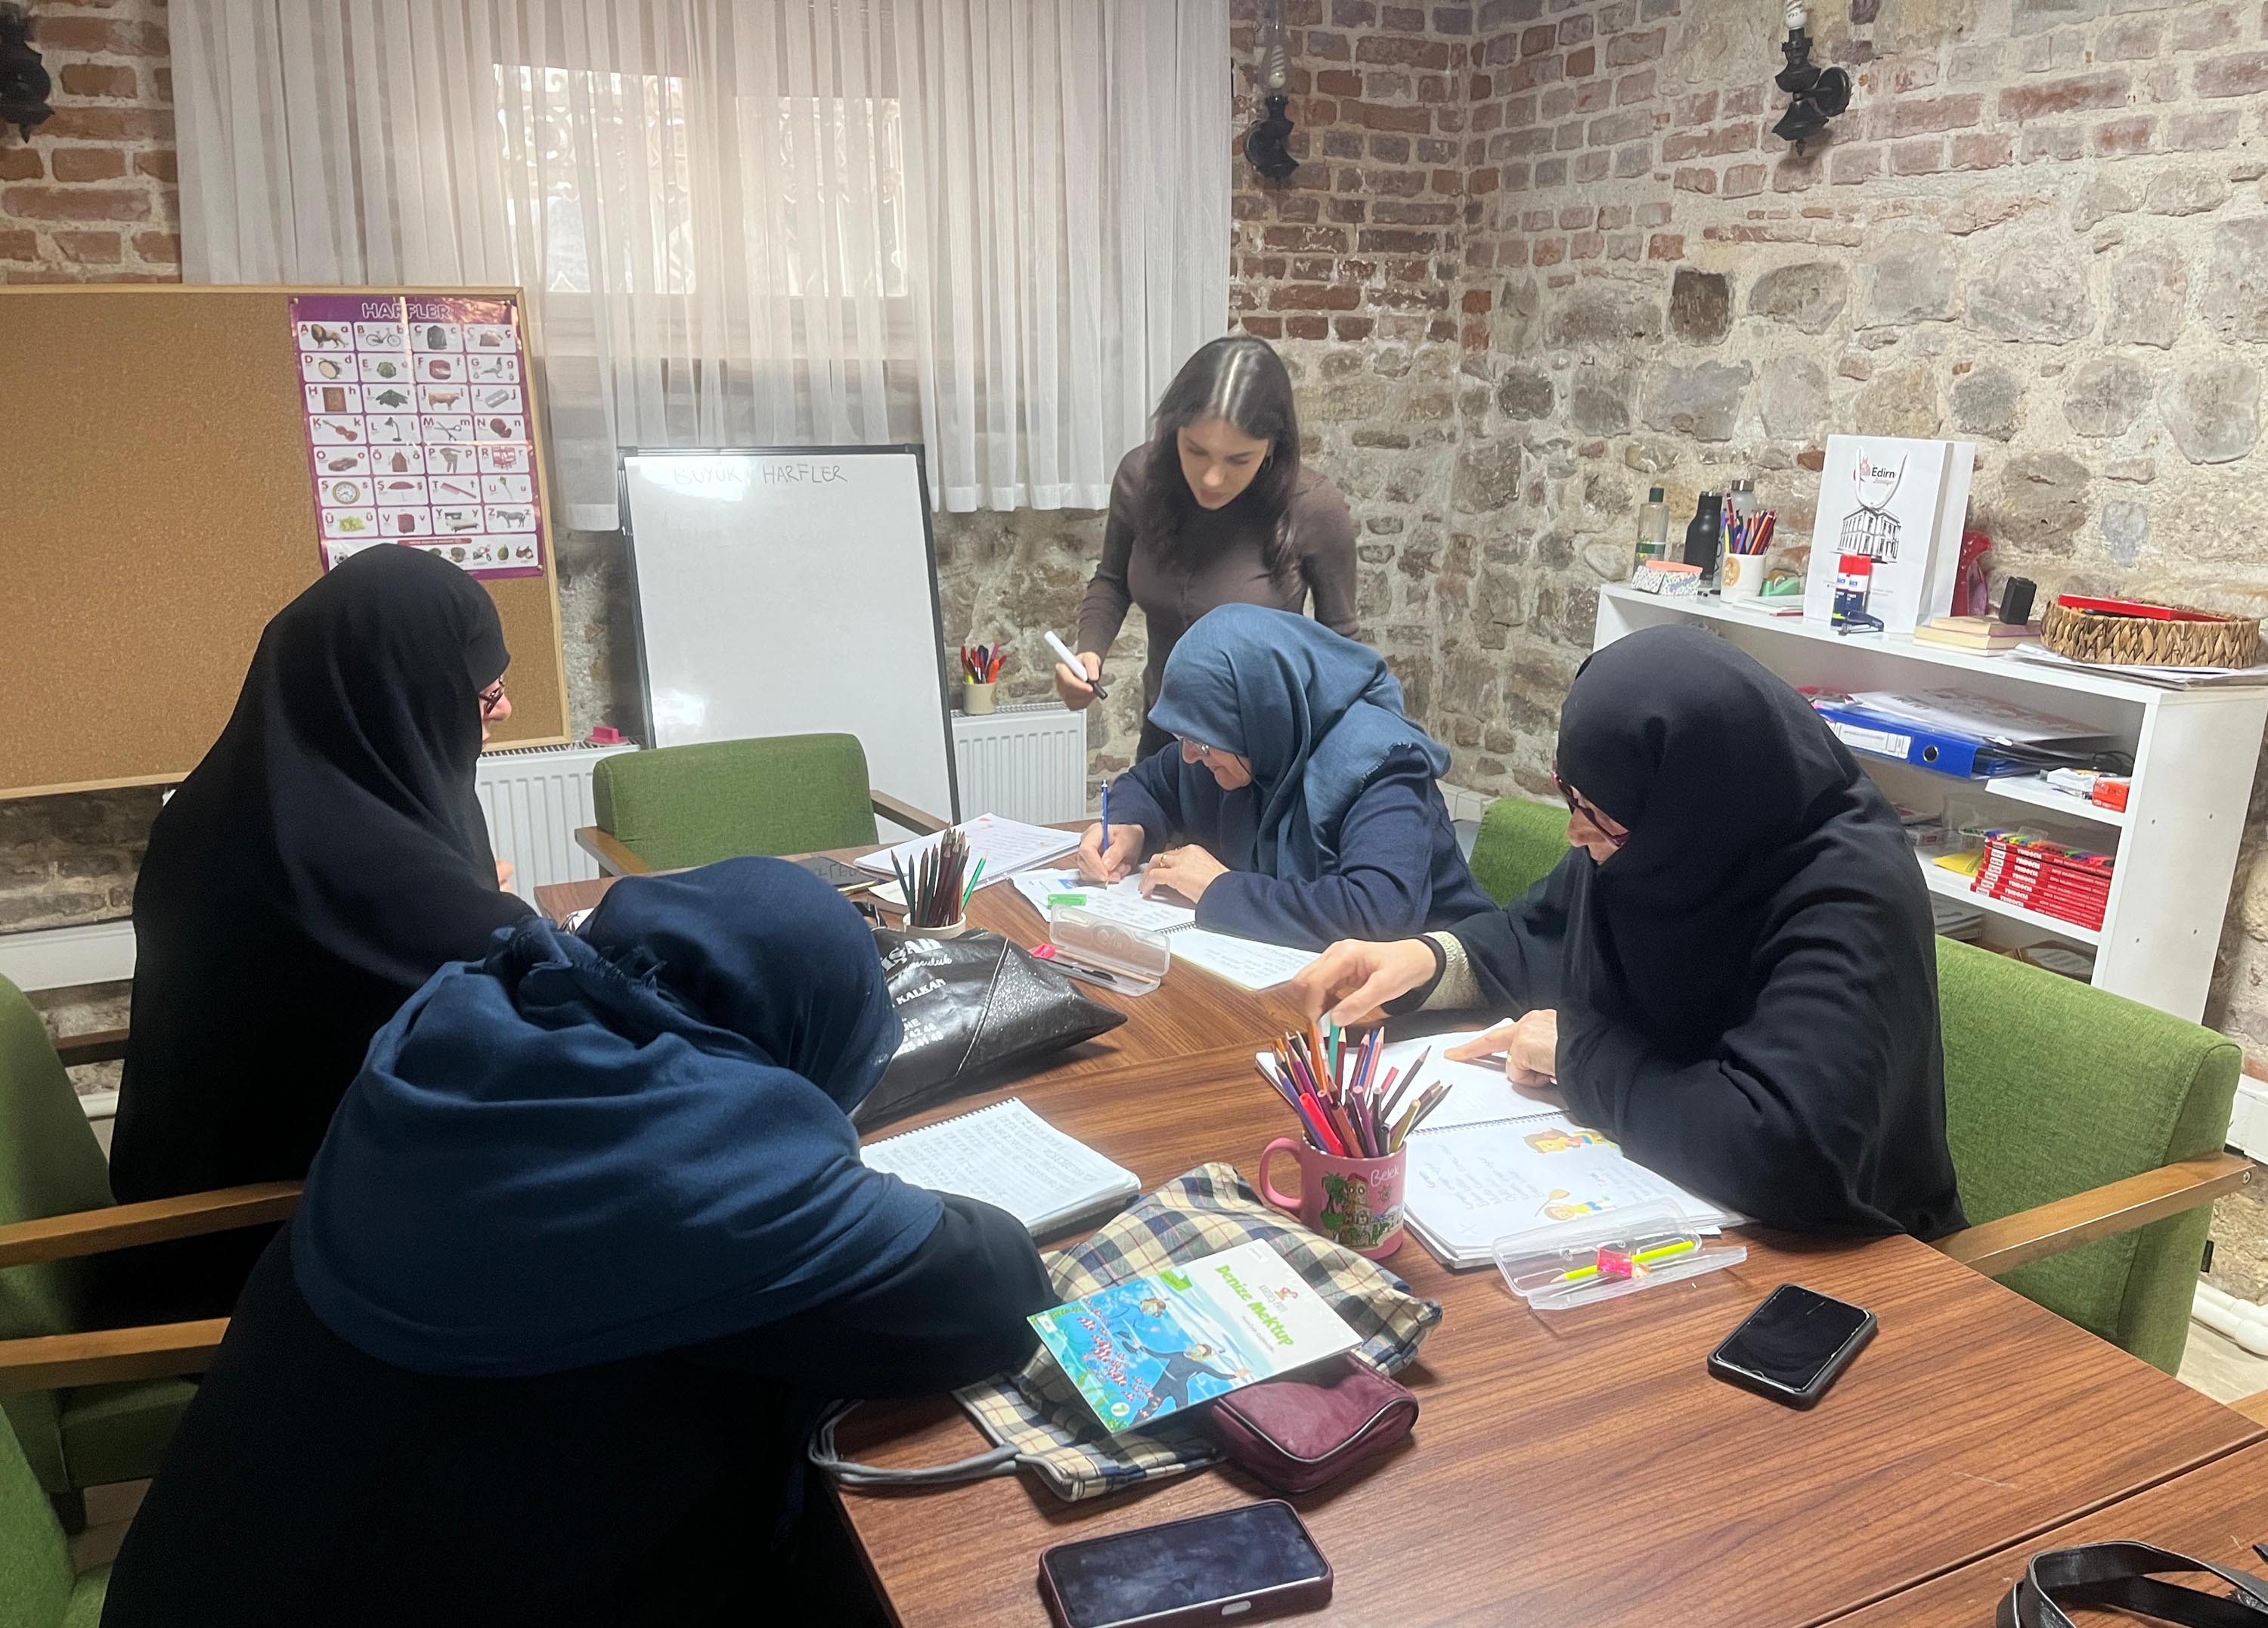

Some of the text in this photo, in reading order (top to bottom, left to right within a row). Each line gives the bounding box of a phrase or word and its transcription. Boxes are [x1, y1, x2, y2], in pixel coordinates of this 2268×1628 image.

[301, 324, 309, 333] A
[358, 325, 364, 333] B
[305, 355, 313, 364] D
[363, 359, 369, 367] E
[418, 357, 423, 366] F
[472, 358, 480, 367] G
[308, 386, 318, 395] H
[476, 389, 481, 397] J
[313, 417, 322, 426] K
[423, 417, 434, 426] M
[477, 418, 486, 426] N
[371, 422, 378, 431] L
[316, 450, 327, 460] O
[373, 448, 383, 460] Ö
[429, 448, 435, 457] P
[482, 448, 489, 457] R
[762, 464, 848, 485] HARFLER
[1871, 465, 1896, 479] Edirn
[321, 480, 329, 489] S
[377, 481, 385, 492] Ş
[432, 480, 439, 488] T
[435, 508, 443, 516] Y
[383, 513, 390, 523] V
[896, 978, 947, 1005] KALKAN
[1214, 1264, 1253, 1301] Denize
[1247, 1301, 1295, 1347] Mektup
